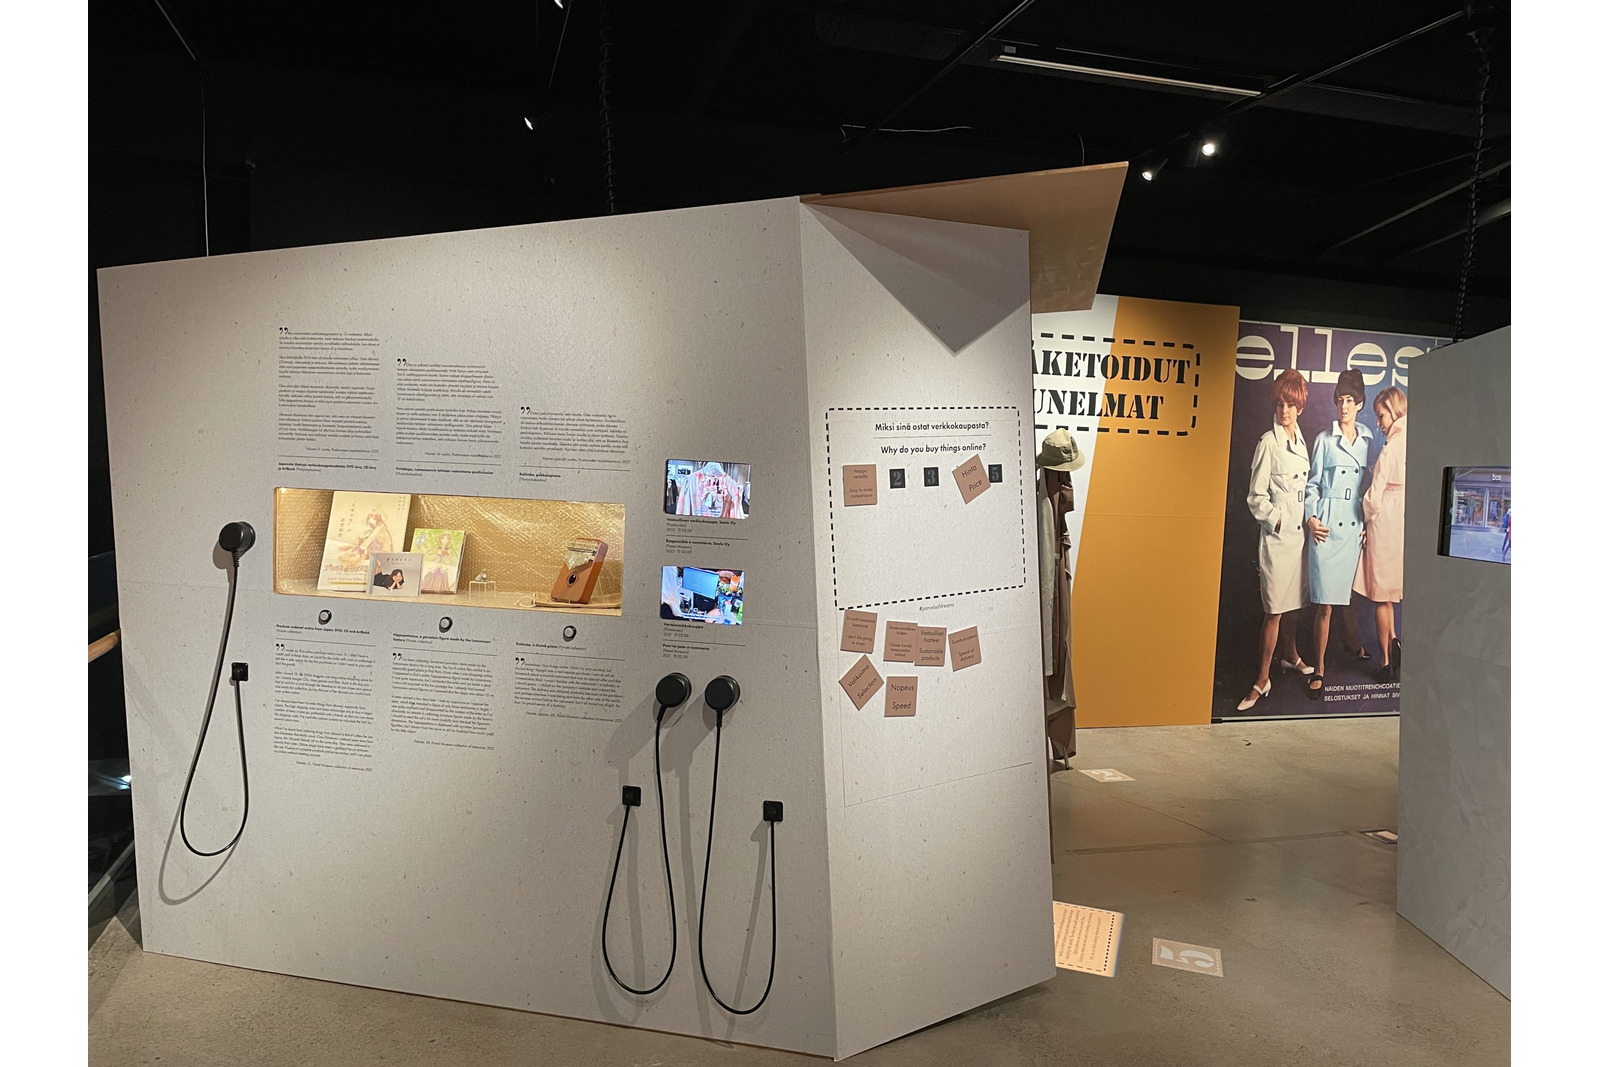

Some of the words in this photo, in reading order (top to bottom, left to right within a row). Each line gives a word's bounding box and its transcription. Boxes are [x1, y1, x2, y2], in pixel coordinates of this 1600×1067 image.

[1235, 325, 1437, 386] elles
[875, 423, 894, 431] Miksi
[931, 422, 989, 431] verkkokaupasta?
[881, 446, 897, 455] Why
[900, 445, 908, 453] do
[926, 445, 938, 454] buy
[940, 444, 960, 453] things
[927, 469, 936, 484] 3
[961, 465, 977, 478] Hinta
[991, 467, 999, 481] 5
[893, 471, 902, 486] 2
[968, 479, 983, 492] Price
[848, 665, 870, 687] Valikoima
[857, 677, 878, 699] Selection
[891, 684, 914, 693] Nopeus
[892, 702, 912, 711] Speed
